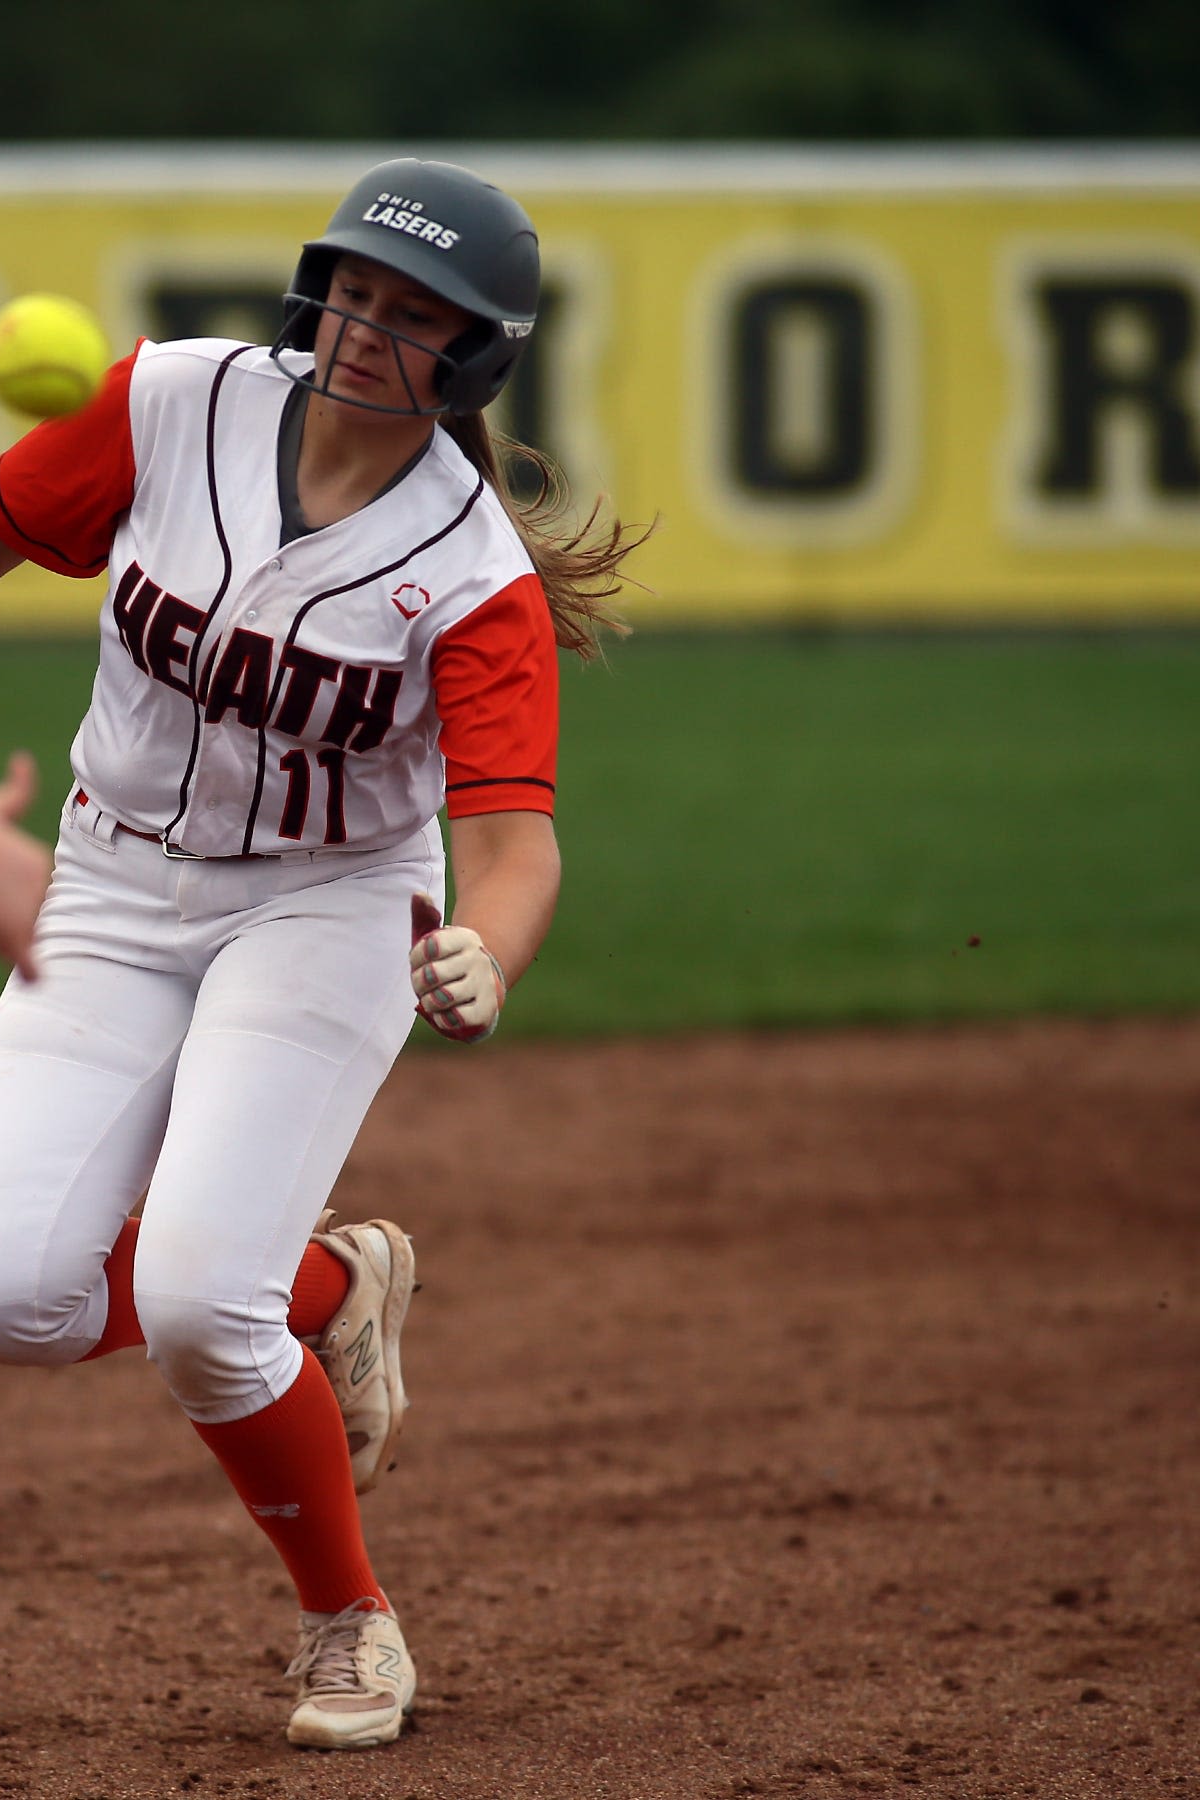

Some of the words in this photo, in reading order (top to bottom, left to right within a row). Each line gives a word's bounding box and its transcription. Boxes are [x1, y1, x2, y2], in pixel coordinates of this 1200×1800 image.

[362, 202, 462, 251] LASERS
[377, 191, 425, 213] OHIO
[112, 559, 404, 754] HEATH
[277, 747, 347, 845] 11
